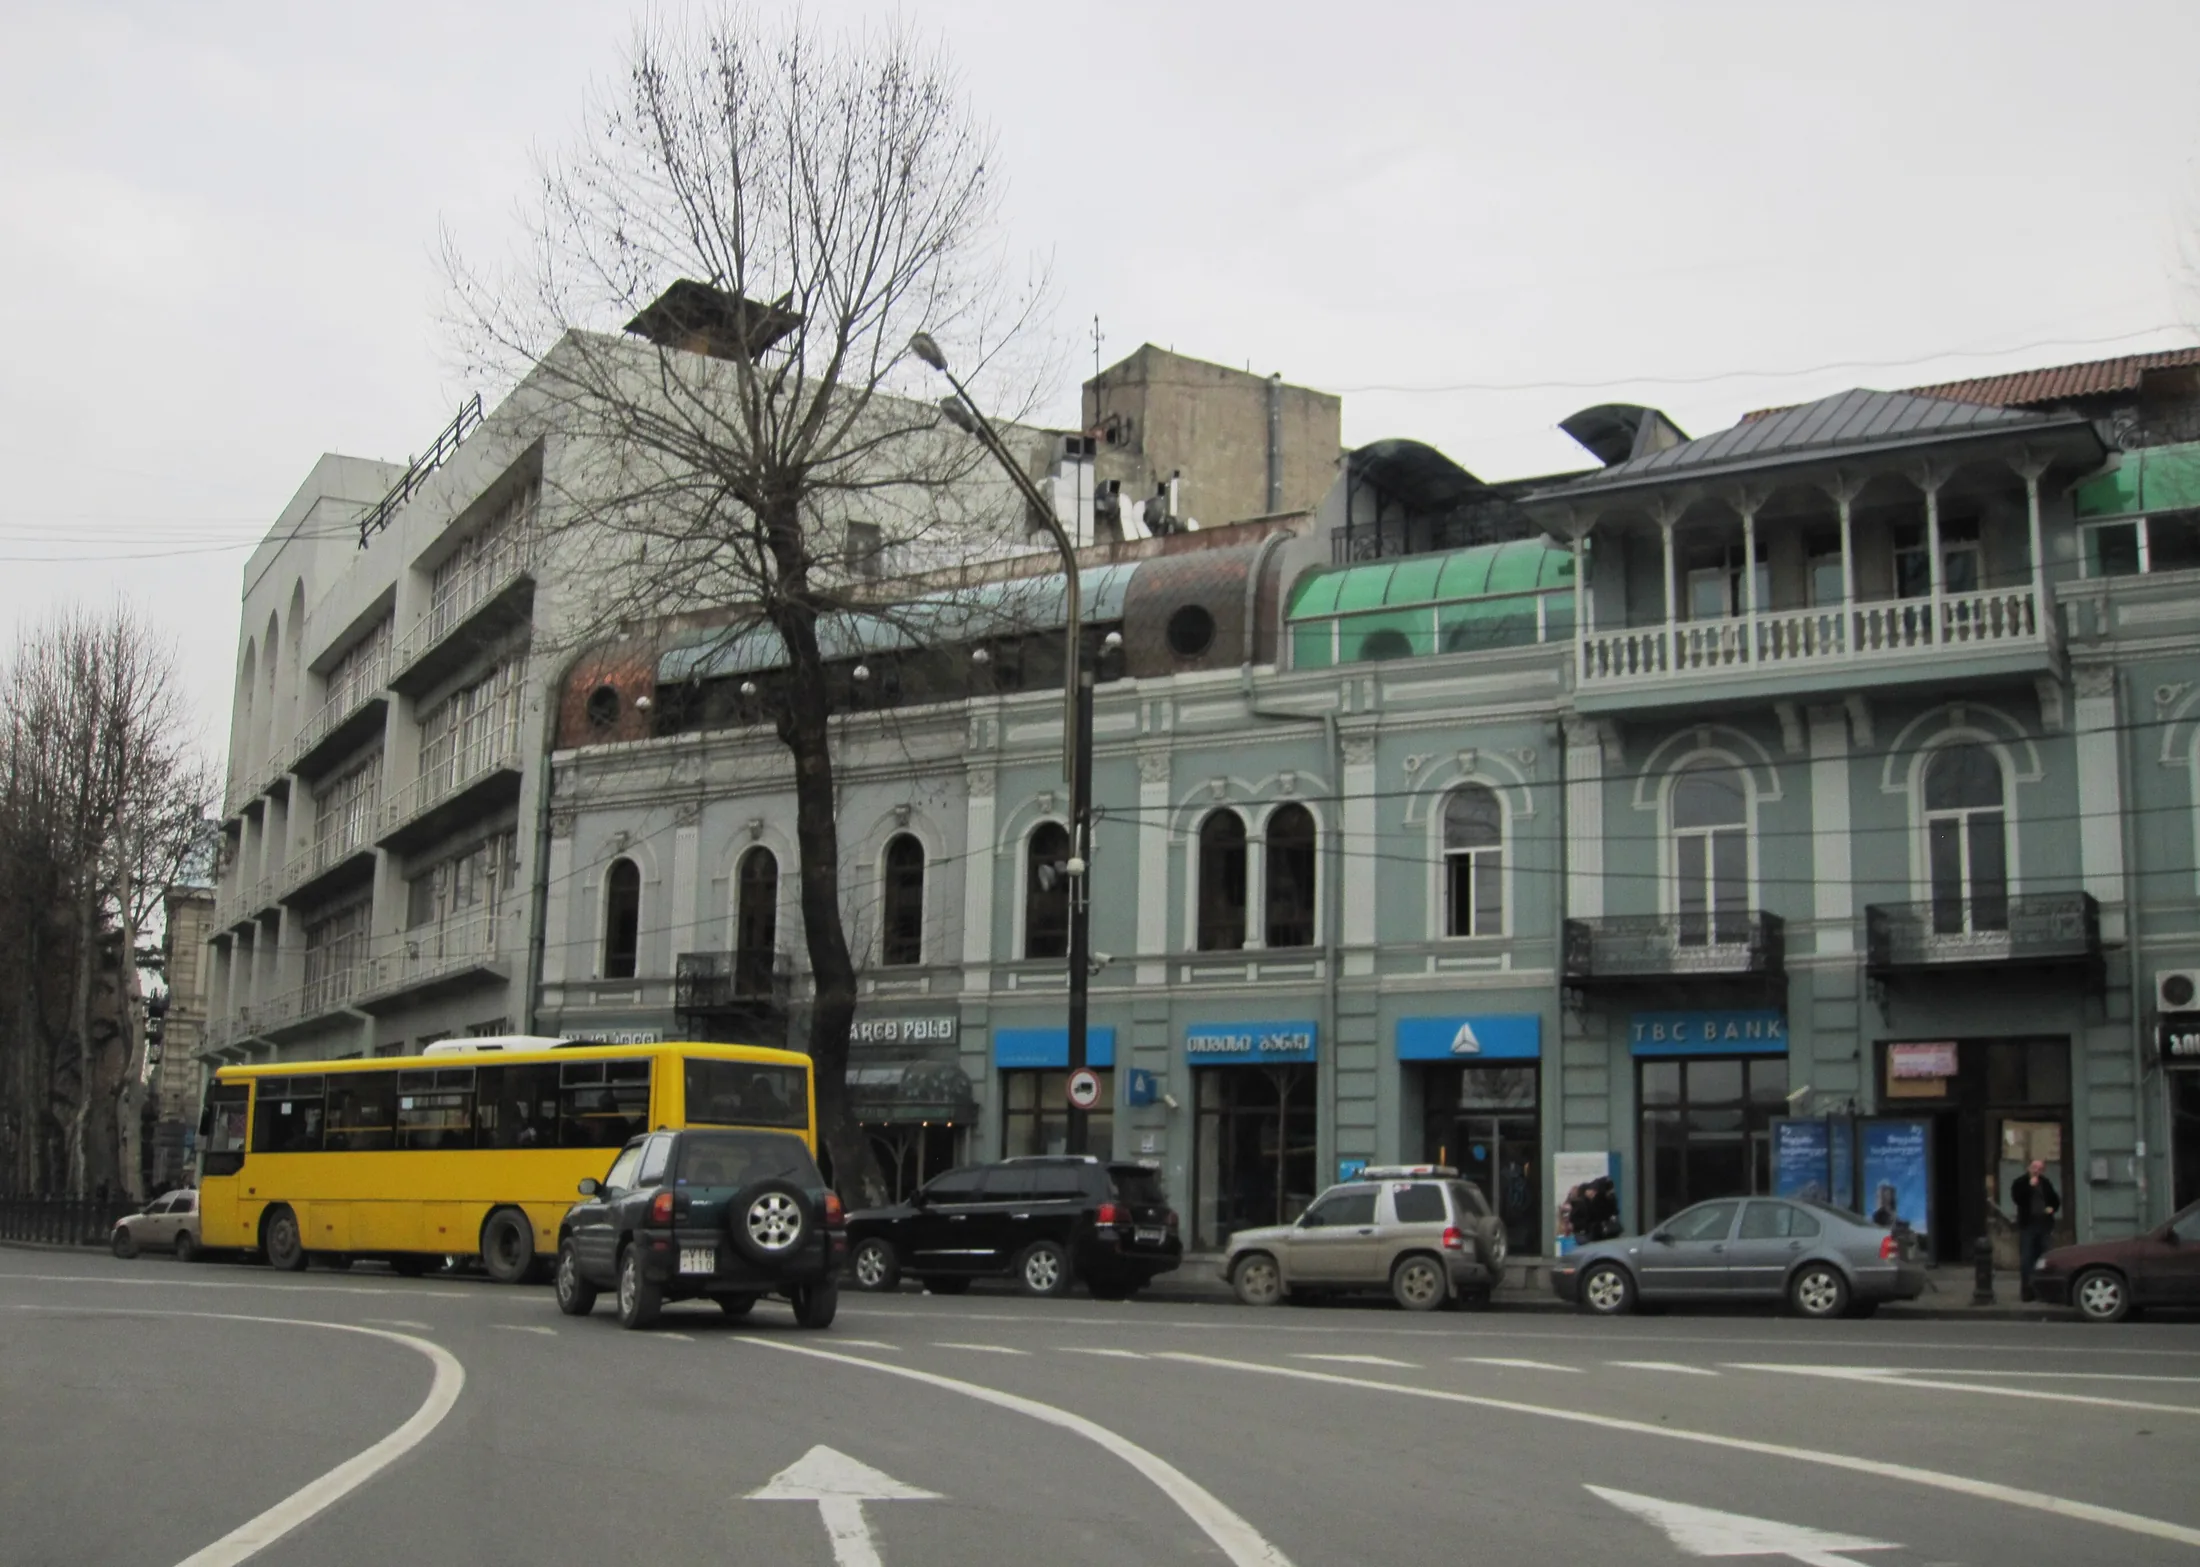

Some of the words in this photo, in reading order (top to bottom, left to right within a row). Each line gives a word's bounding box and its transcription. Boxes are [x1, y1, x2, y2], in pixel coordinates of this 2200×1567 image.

[850, 1021, 898, 1041] ARCO
[903, 1020, 951, 1039] POLO
[1634, 1022, 1686, 1041] TBC
[1706, 1020, 1781, 1040] BANK
